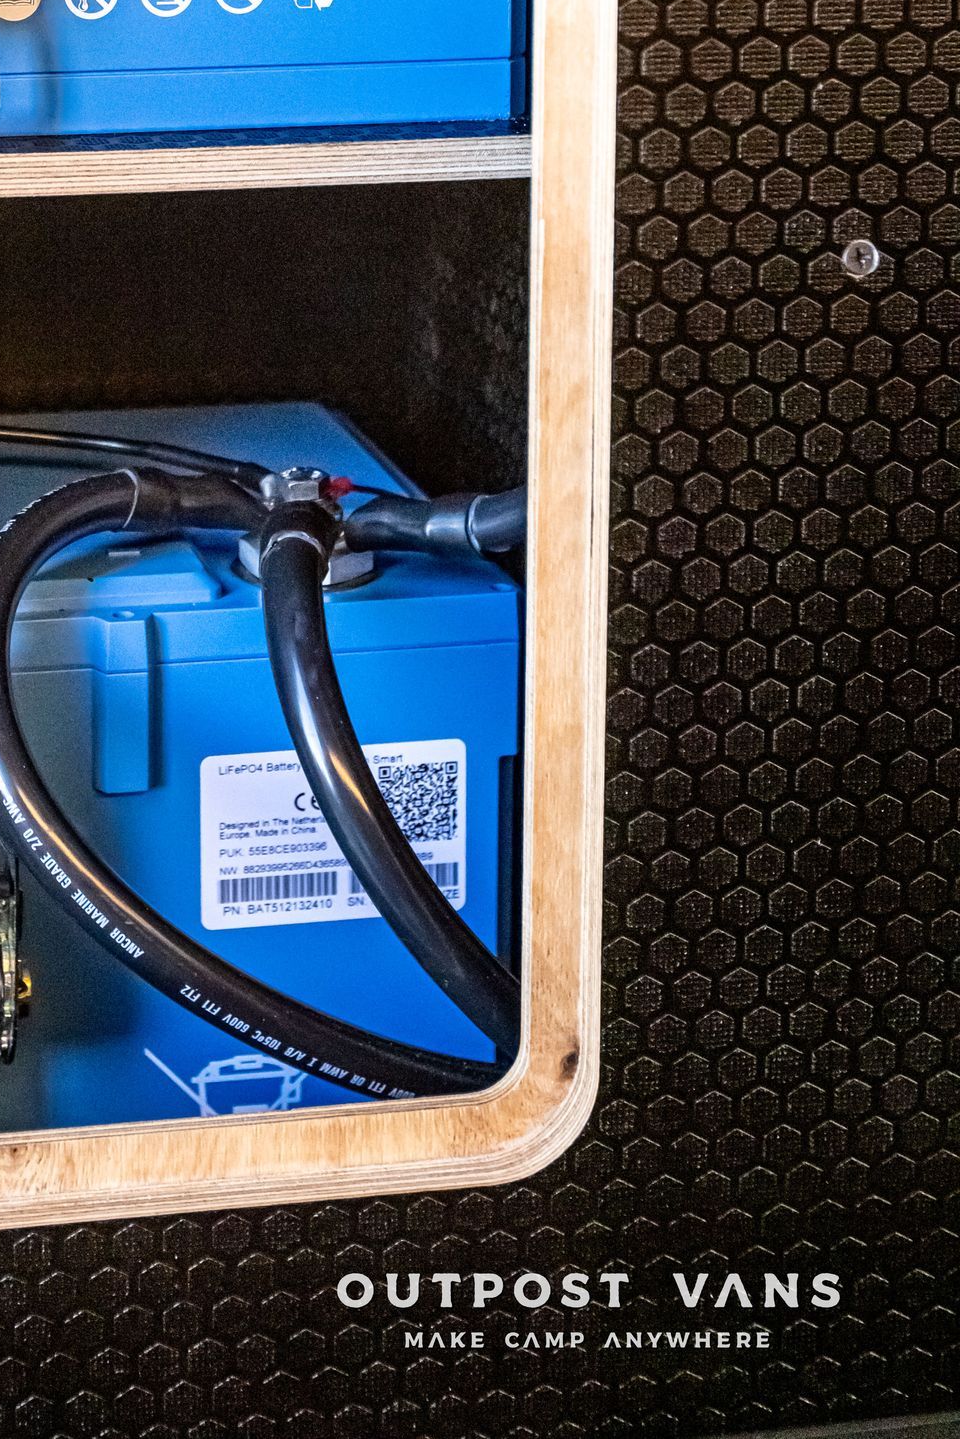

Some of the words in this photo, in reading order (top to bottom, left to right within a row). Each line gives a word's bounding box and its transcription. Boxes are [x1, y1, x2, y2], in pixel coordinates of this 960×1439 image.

[219, 763, 262, 775] LiFePO4
[373, 755, 403, 764] Smart
[219, 821, 259, 831] Designed
[255, 829, 278, 837] Made
[291, 827, 316, 835] China
[23, 828, 43, 851] 2/0
[40, 852, 72, 888] GRADE
[71, 888, 109, 928] MARINE
[248, 899, 333, 914] BAT512132410
[110, 927, 145, 958] ANCOR
[179, 985, 201, 1003] FT2
[202, 999, 221, 1016] FT1
[222, 1013, 250, 1033] 600V
[284, 1048, 306, 1061] A/B
[319, 1063, 349, 1083] AWM
